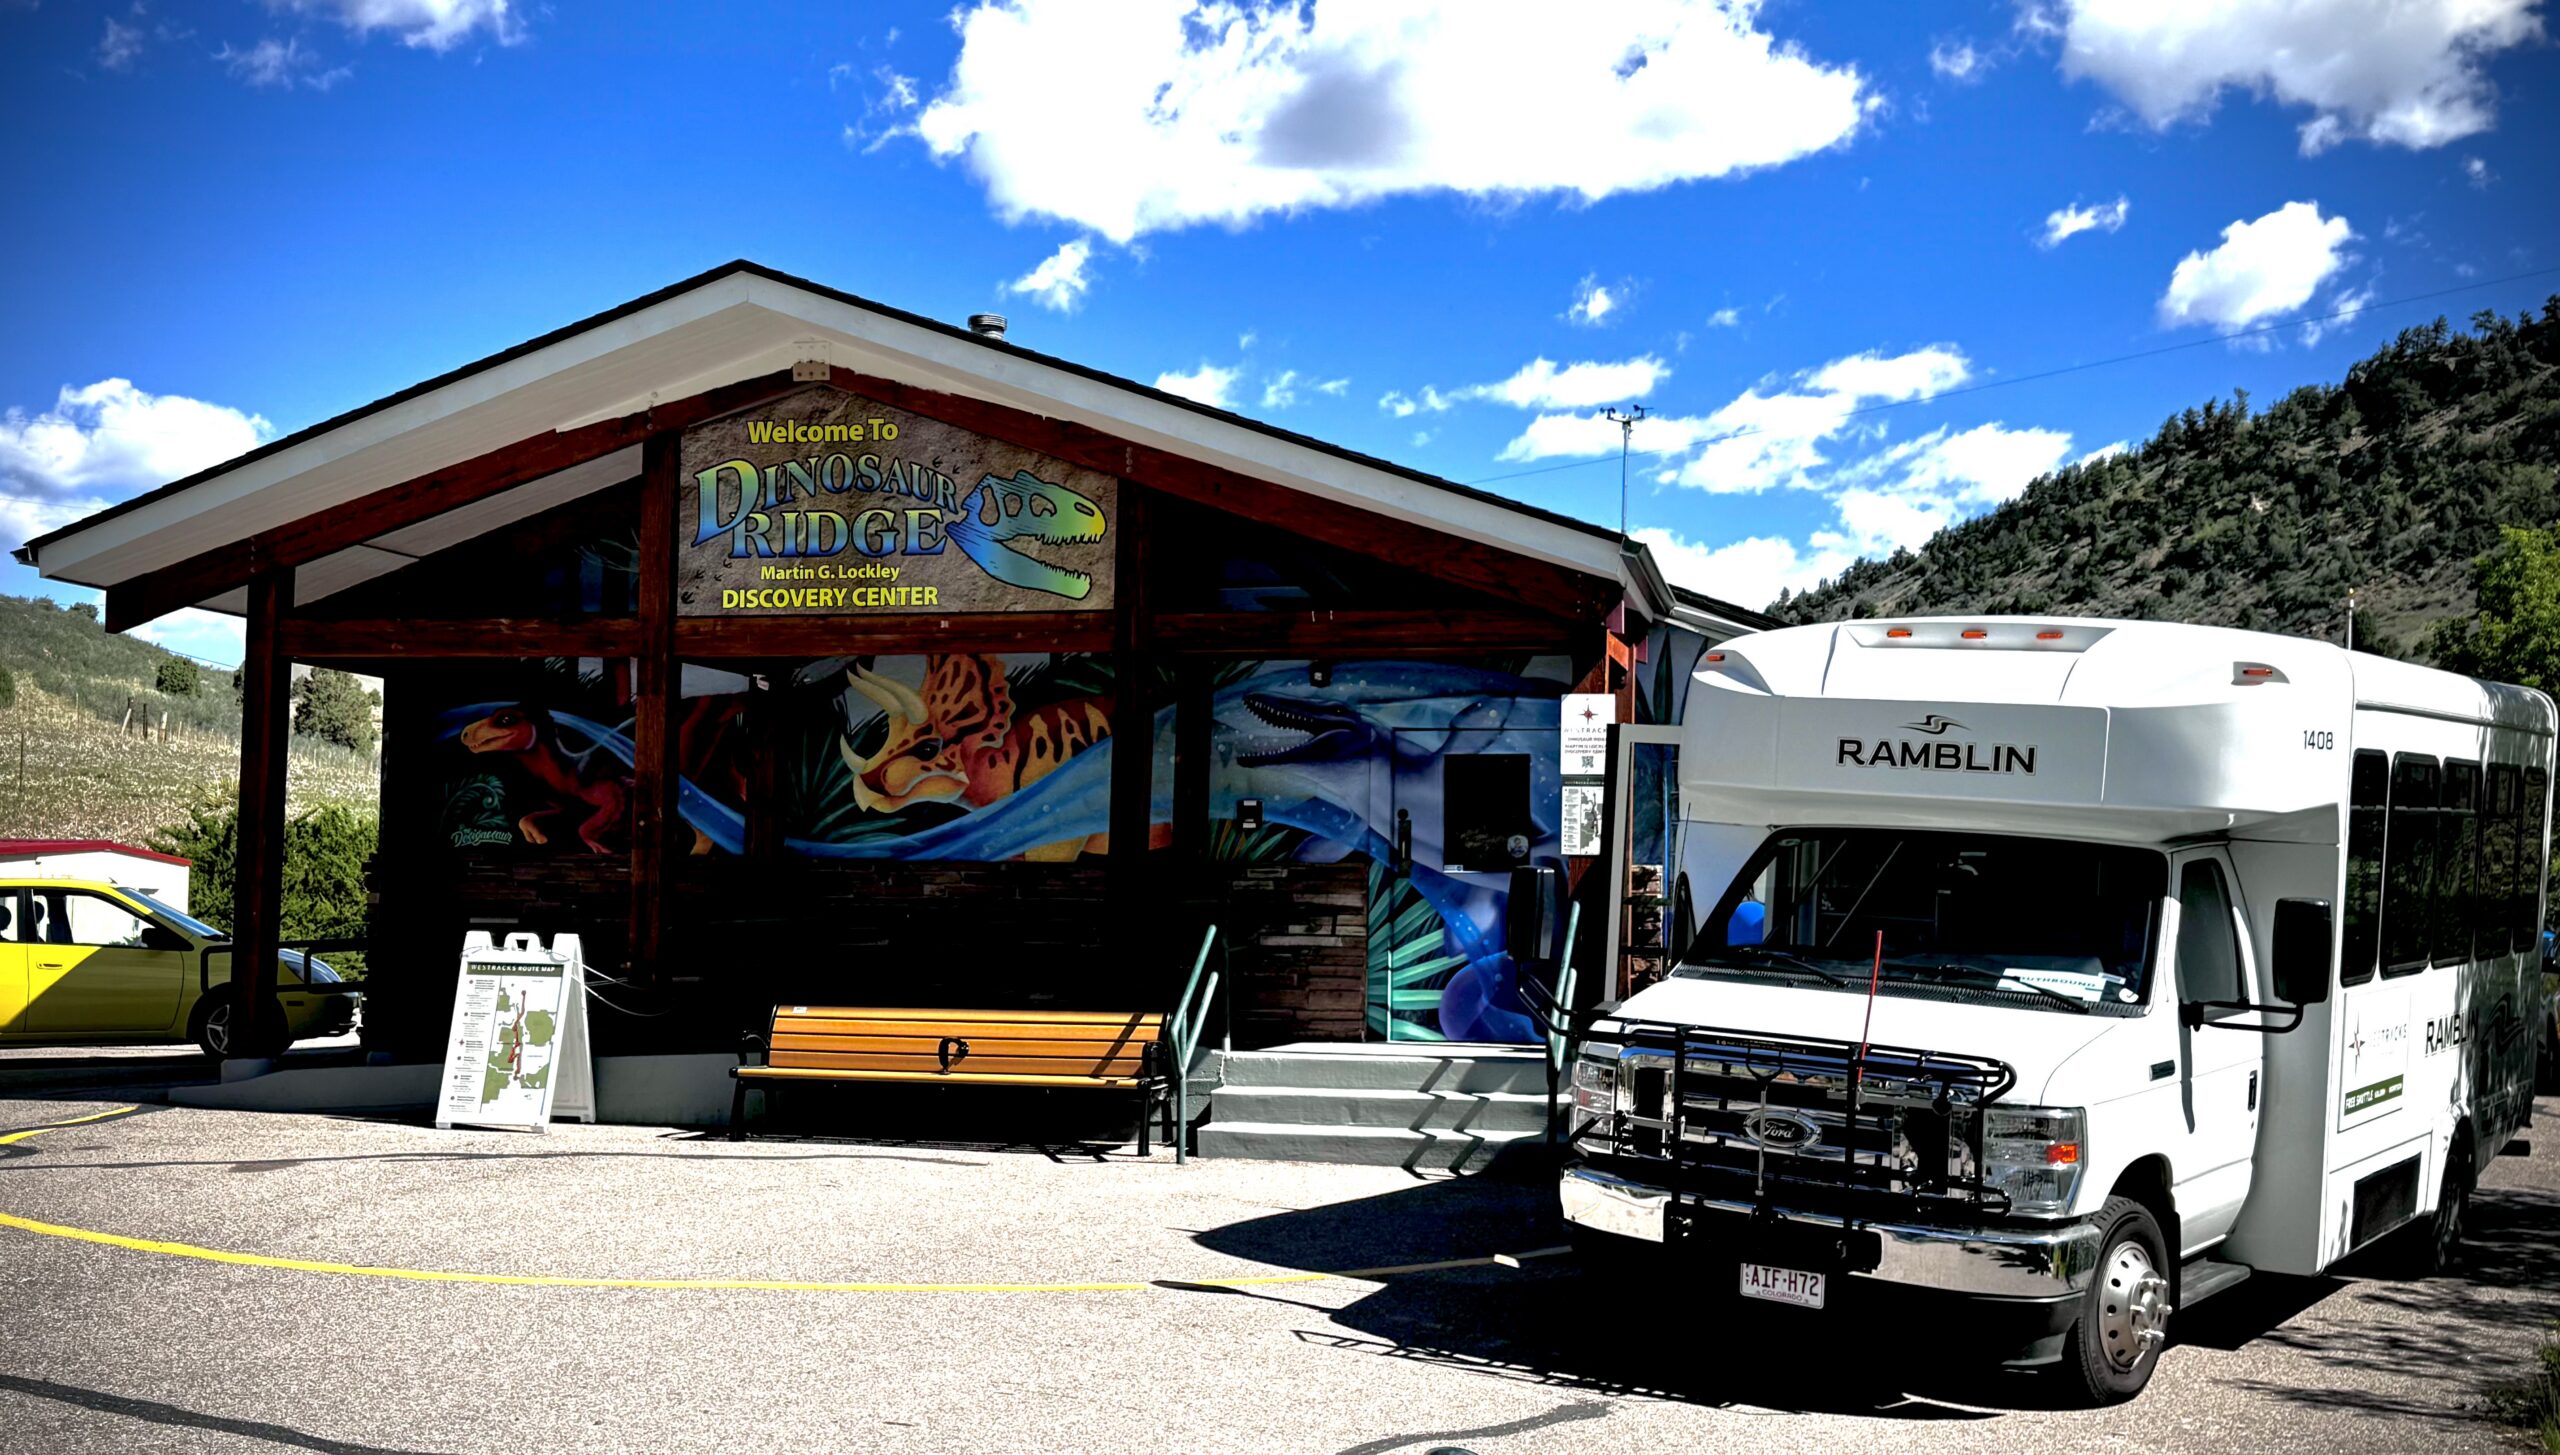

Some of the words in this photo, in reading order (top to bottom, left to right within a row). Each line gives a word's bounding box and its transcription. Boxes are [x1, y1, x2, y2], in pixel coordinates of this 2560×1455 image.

[748, 419, 864, 444] Welcome
[867, 418, 899, 441] To
[691, 453, 959, 548] DINOSAUR
[728, 508, 948, 558] RIDGE
[760, 565, 815, 580] Martin
[817, 565, 836, 580] G.
[838, 564, 900, 582] Lockley
[722, 587, 848, 609] DISCOVERY
[852, 586, 938, 607] CENTER
[2303, 730, 2333, 750] 1408
[1836, 738, 2036, 774] RAMBLIN
[2425, 1007, 2480, 1055] RAMBLIN
[1764, 1120, 1796, 1138] Ford
[1762, 1289, 1803, 1301] COLORADO
